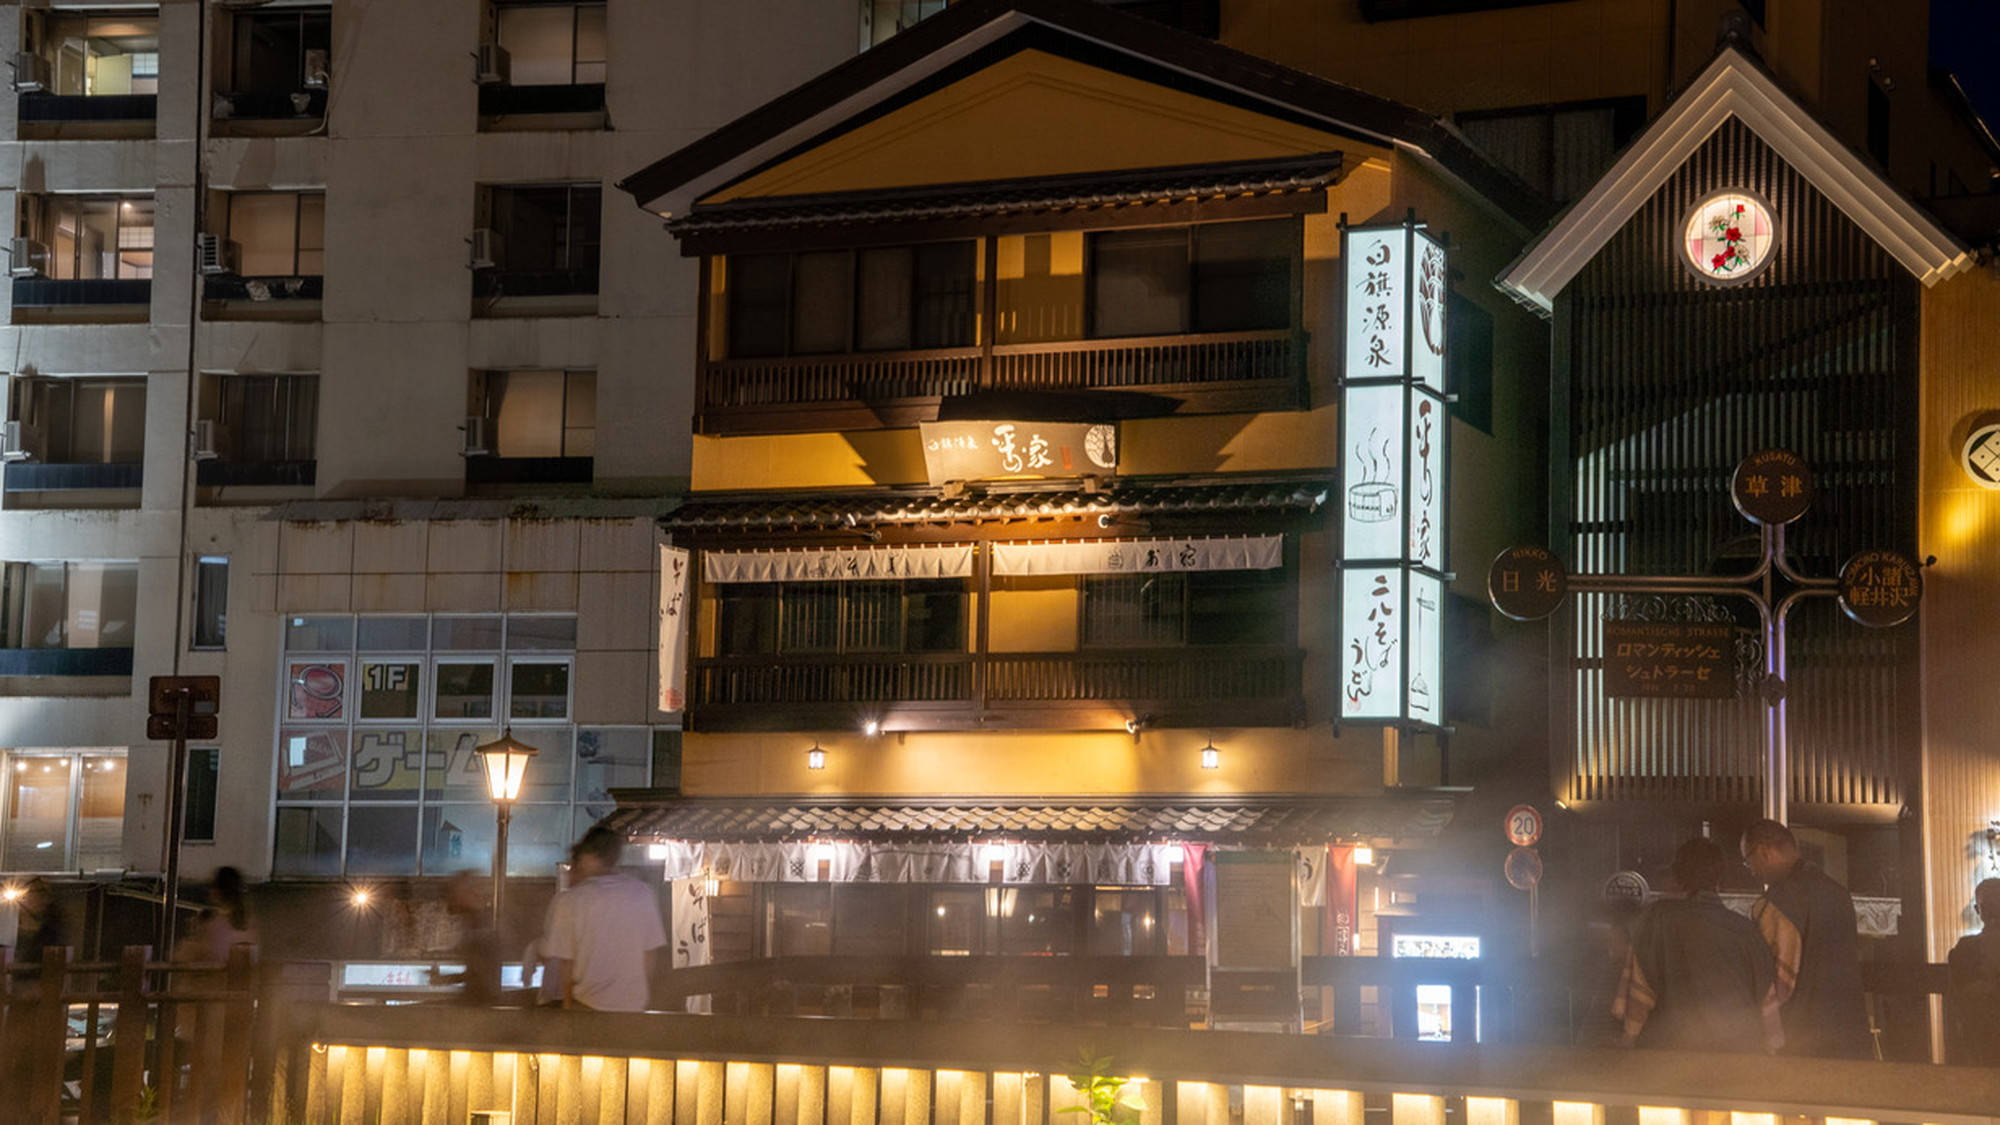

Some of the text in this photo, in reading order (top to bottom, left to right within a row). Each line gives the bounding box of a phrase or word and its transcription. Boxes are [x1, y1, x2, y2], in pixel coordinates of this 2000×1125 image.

[1355, 239, 1393, 368] 白旗源泉
[1745, 474, 1803, 498] 草津
[1145, 543, 1197, 568] お宿
[1502, 569, 1557, 593] 日光
[1849, 586, 1909, 608] 軽井沢
[1365, 575, 1398, 671] 二八そば
[1616, 642, 1721, 659] ロマンティッシェ
[367, 664, 409, 691] 1F
[1346, 638, 1373, 703] うどん
[1625, 664, 1712, 681] シュトラーセ
[354, 731, 486, 789] ゲーム
[1513, 817, 1535, 836] 20
